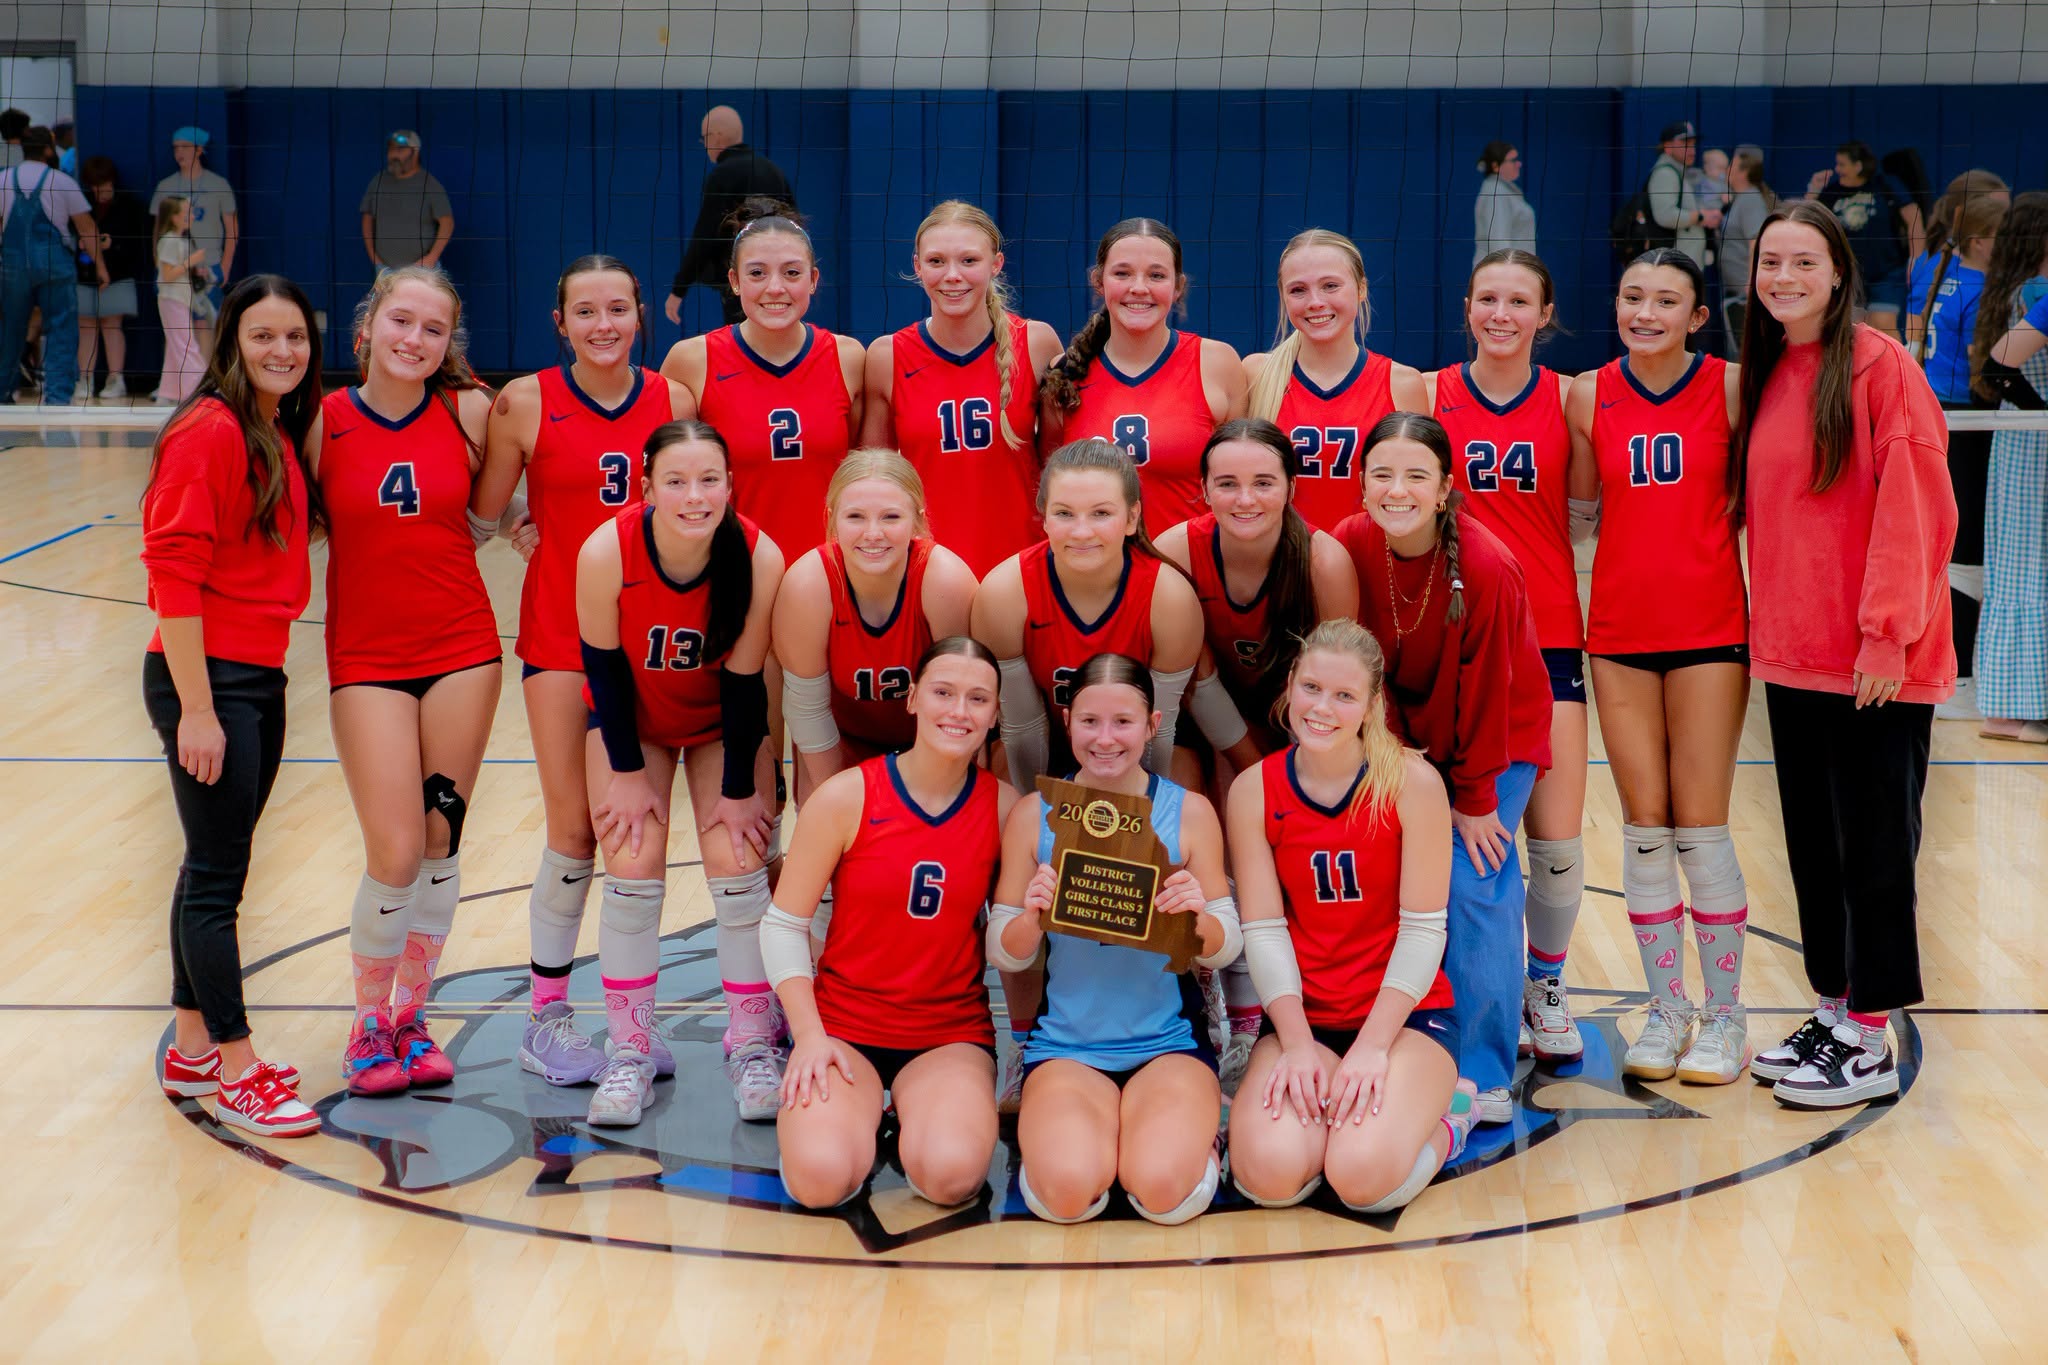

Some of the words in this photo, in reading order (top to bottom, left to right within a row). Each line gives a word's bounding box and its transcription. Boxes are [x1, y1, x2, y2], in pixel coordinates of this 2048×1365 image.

[768, 408, 803, 462] 2
[937, 397, 993, 454] 16
[1112, 413, 1151, 467] 8
[1290, 425, 1359, 479] 27
[599, 452, 631, 506] 3
[1465, 440, 1538, 493] 24
[1628, 432, 1684, 488] 10
[377, 461, 421, 518] 4
[644, 624, 705, 672] 13
[853, 666, 914, 702] 12
[1059, 802, 1083, 822] 20
[1119, 815, 1142, 833] 26
[906, 860, 946, 920] 6
[1070, 875, 1144, 899] VOLLEYBALL
[1082, 864, 1136, 883] DISTRICT
[1310, 850, 1363, 903] 11
[1065, 890, 1099, 905] GIRLS
[1100, 897, 1135, 912] CLASS
[1136, 904, 1144, 914] 2
[1066, 905, 1100, 920] FIRST
[1100, 911, 1137, 927] PLACE
